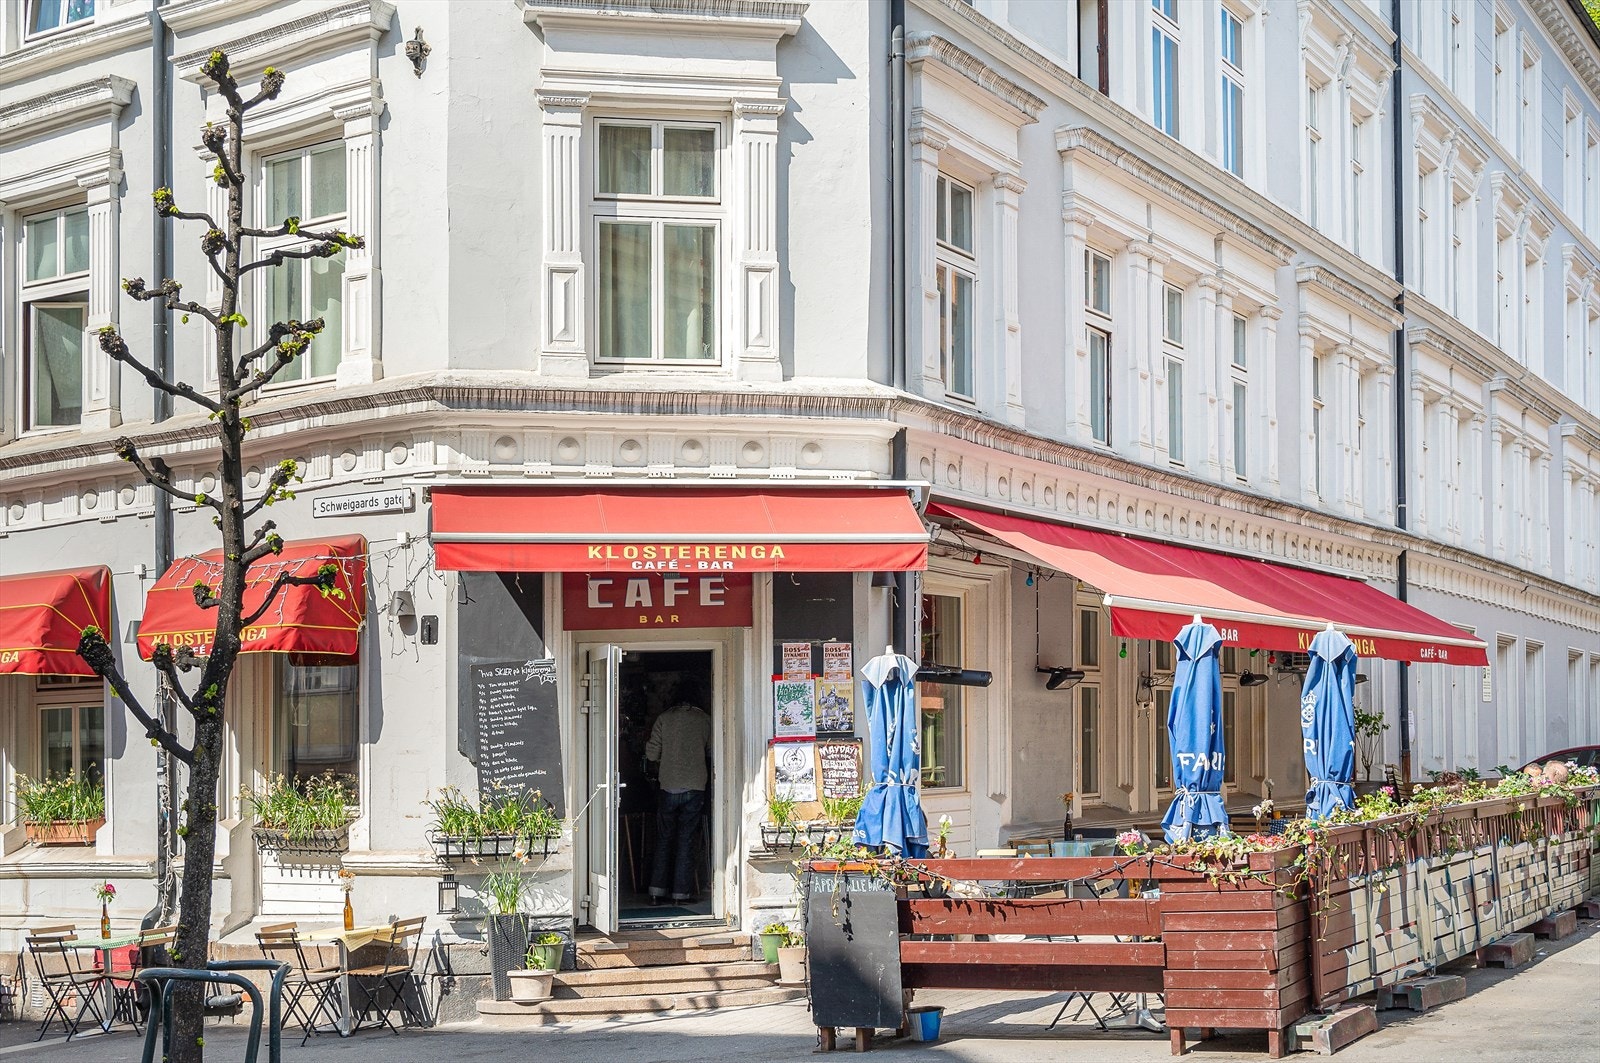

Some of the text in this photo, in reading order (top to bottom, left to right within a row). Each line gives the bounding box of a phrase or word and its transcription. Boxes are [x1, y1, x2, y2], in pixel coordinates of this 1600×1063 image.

[320, 496, 379, 513] Schweigaards
[587, 545, 785, 559] KLOSTERENGA
[631, 559, 679, 570] CAFÉ
[698, 561, 734, 570] BAR
[639, 615, 680, 624] BAR
[151, 627, 268, 647] KLOSTENGA
[1221, 628, 1239, 642] BAR
[0, 651, 20, 664] GA
